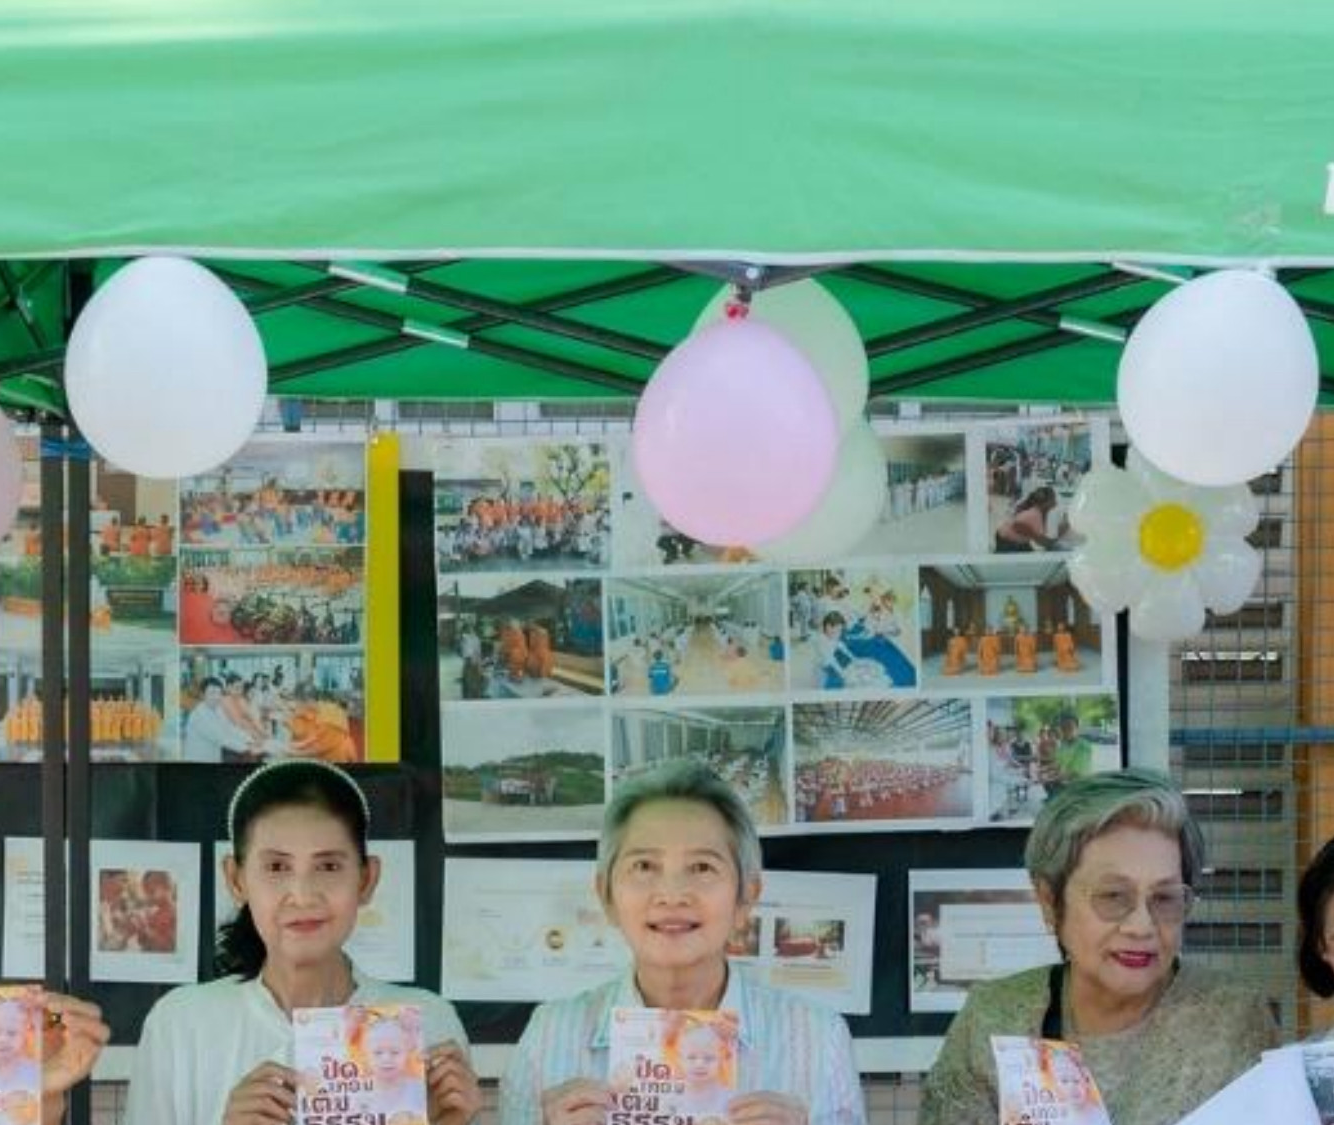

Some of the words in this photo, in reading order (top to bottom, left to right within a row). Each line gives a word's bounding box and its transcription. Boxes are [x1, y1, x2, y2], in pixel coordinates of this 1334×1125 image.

[321, 1055, 358, 1080] ปิด
[635, 1053, 671, 1079] ปิด
[301, 1088, 350, 1114] เต็ม
